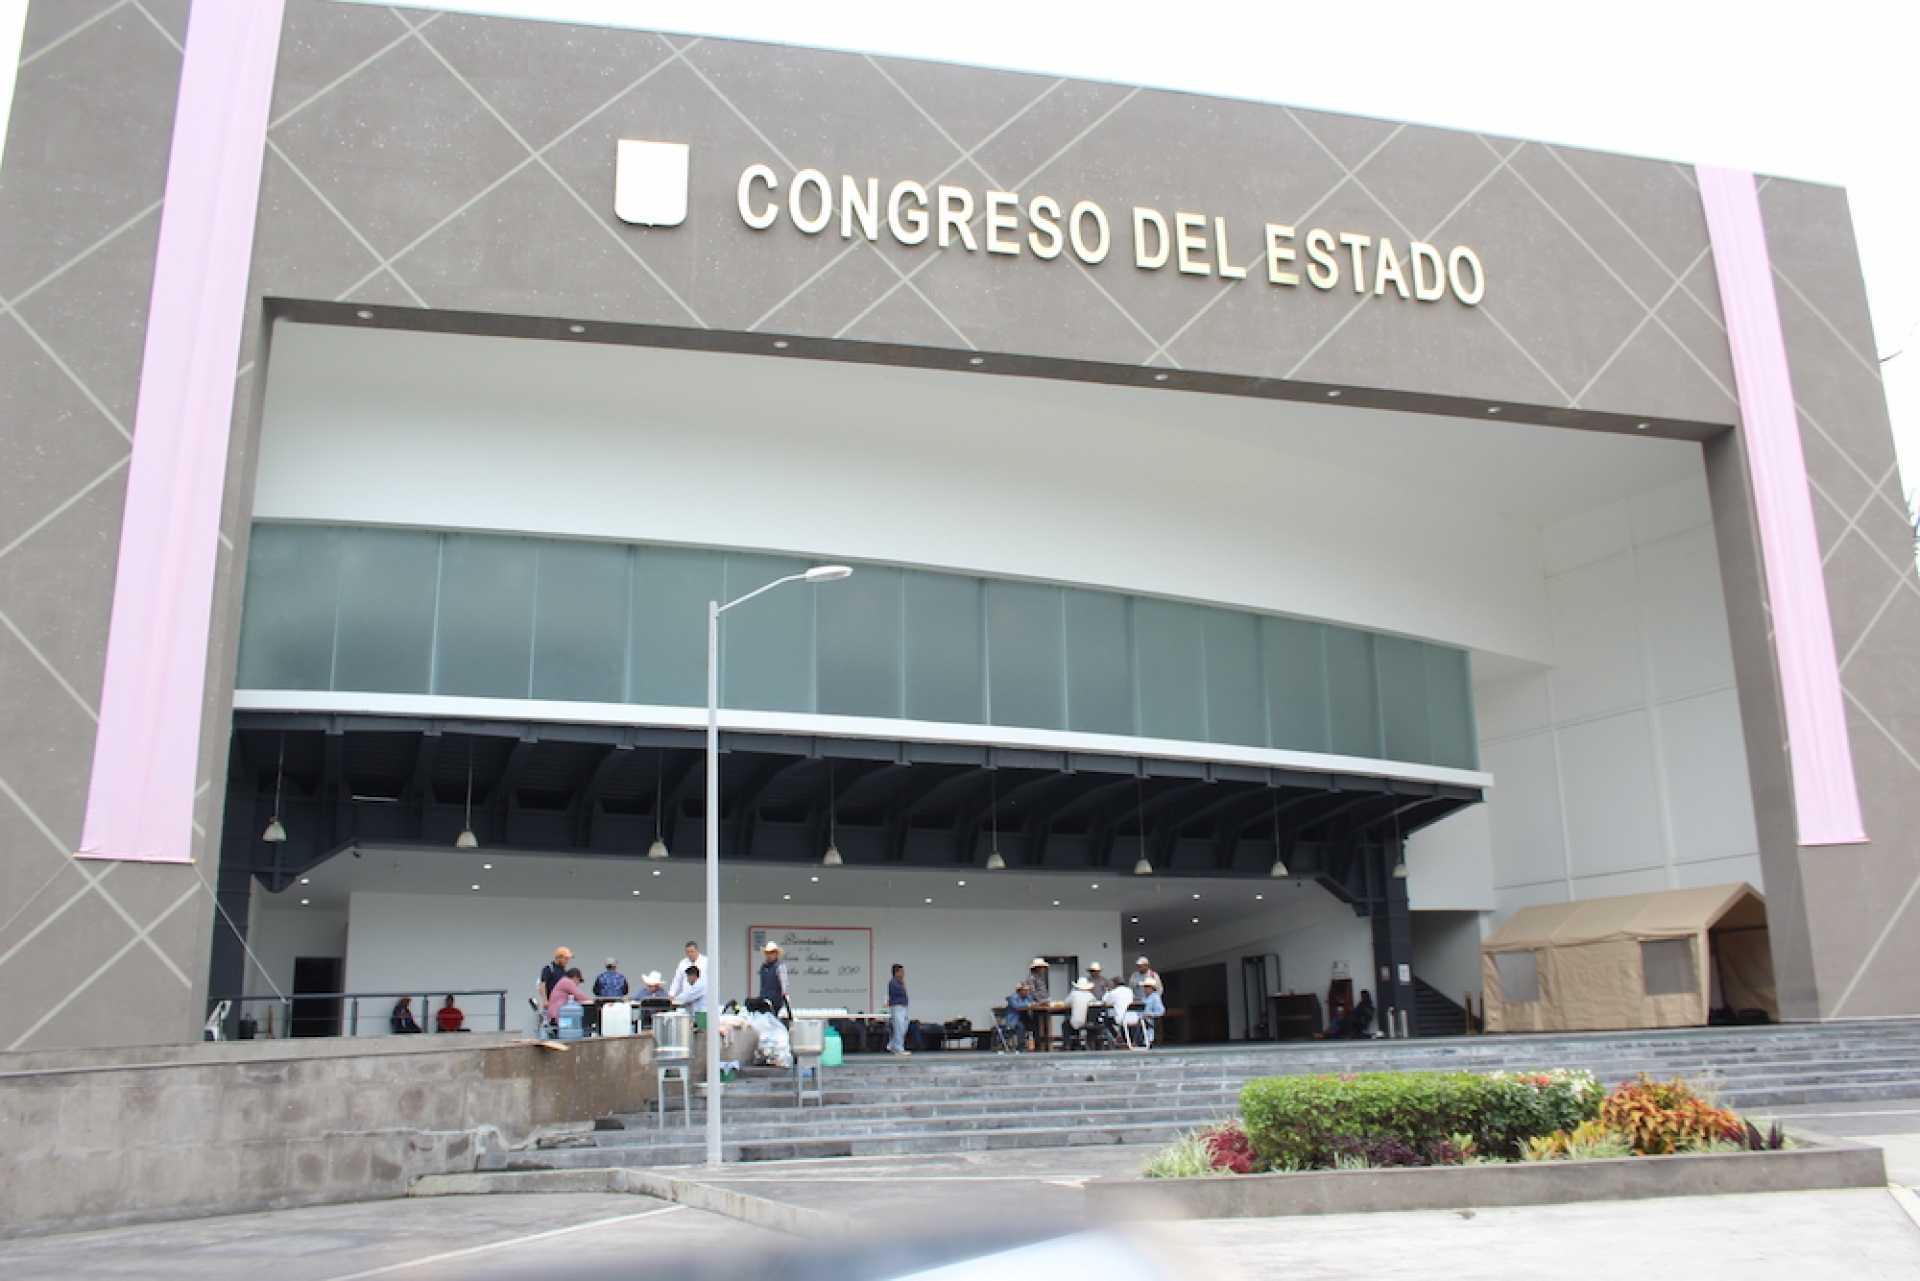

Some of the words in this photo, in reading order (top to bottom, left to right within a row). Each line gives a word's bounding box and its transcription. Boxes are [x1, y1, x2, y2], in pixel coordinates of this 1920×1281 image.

[737, 163, 1111, 264] CONGRESO
[1132, 205, 1247, 280] DEL
[1264, 221, 1486, 305] ESTADO
